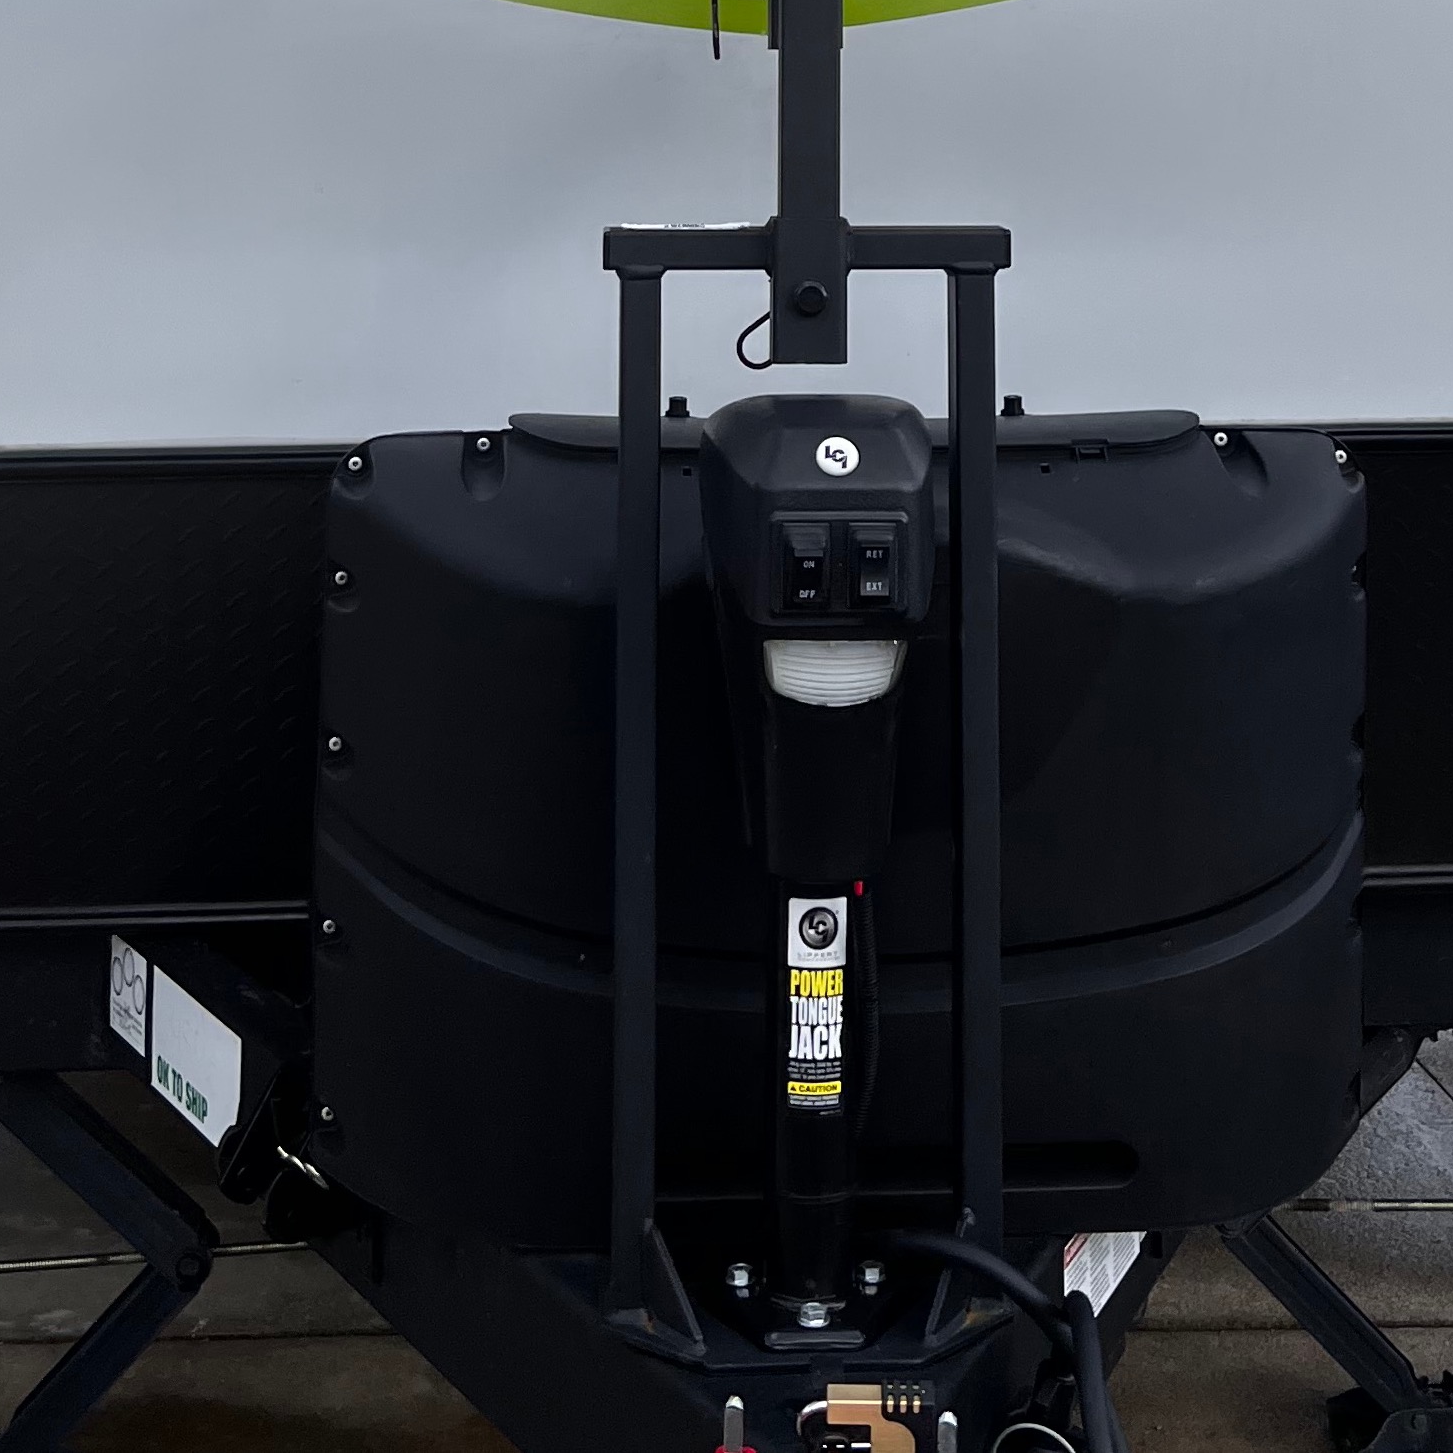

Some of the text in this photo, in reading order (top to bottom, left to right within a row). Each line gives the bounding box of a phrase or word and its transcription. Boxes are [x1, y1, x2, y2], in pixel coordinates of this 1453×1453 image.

[866, 549, 883, 559] RET
[803, 560, 815, 569] ON
[866, 581, 883, 591] EXT
[799, 589, 816, 598] OFF
[790, 968, 843, 998] POWER
[790, 996, 843, 1026] TONGUE
[788, 1024, 842, 1061] JACK
[157, 1055, 209, 1124] OK TO SHIP
[798, 1084, 838, 1093] CAUTION
